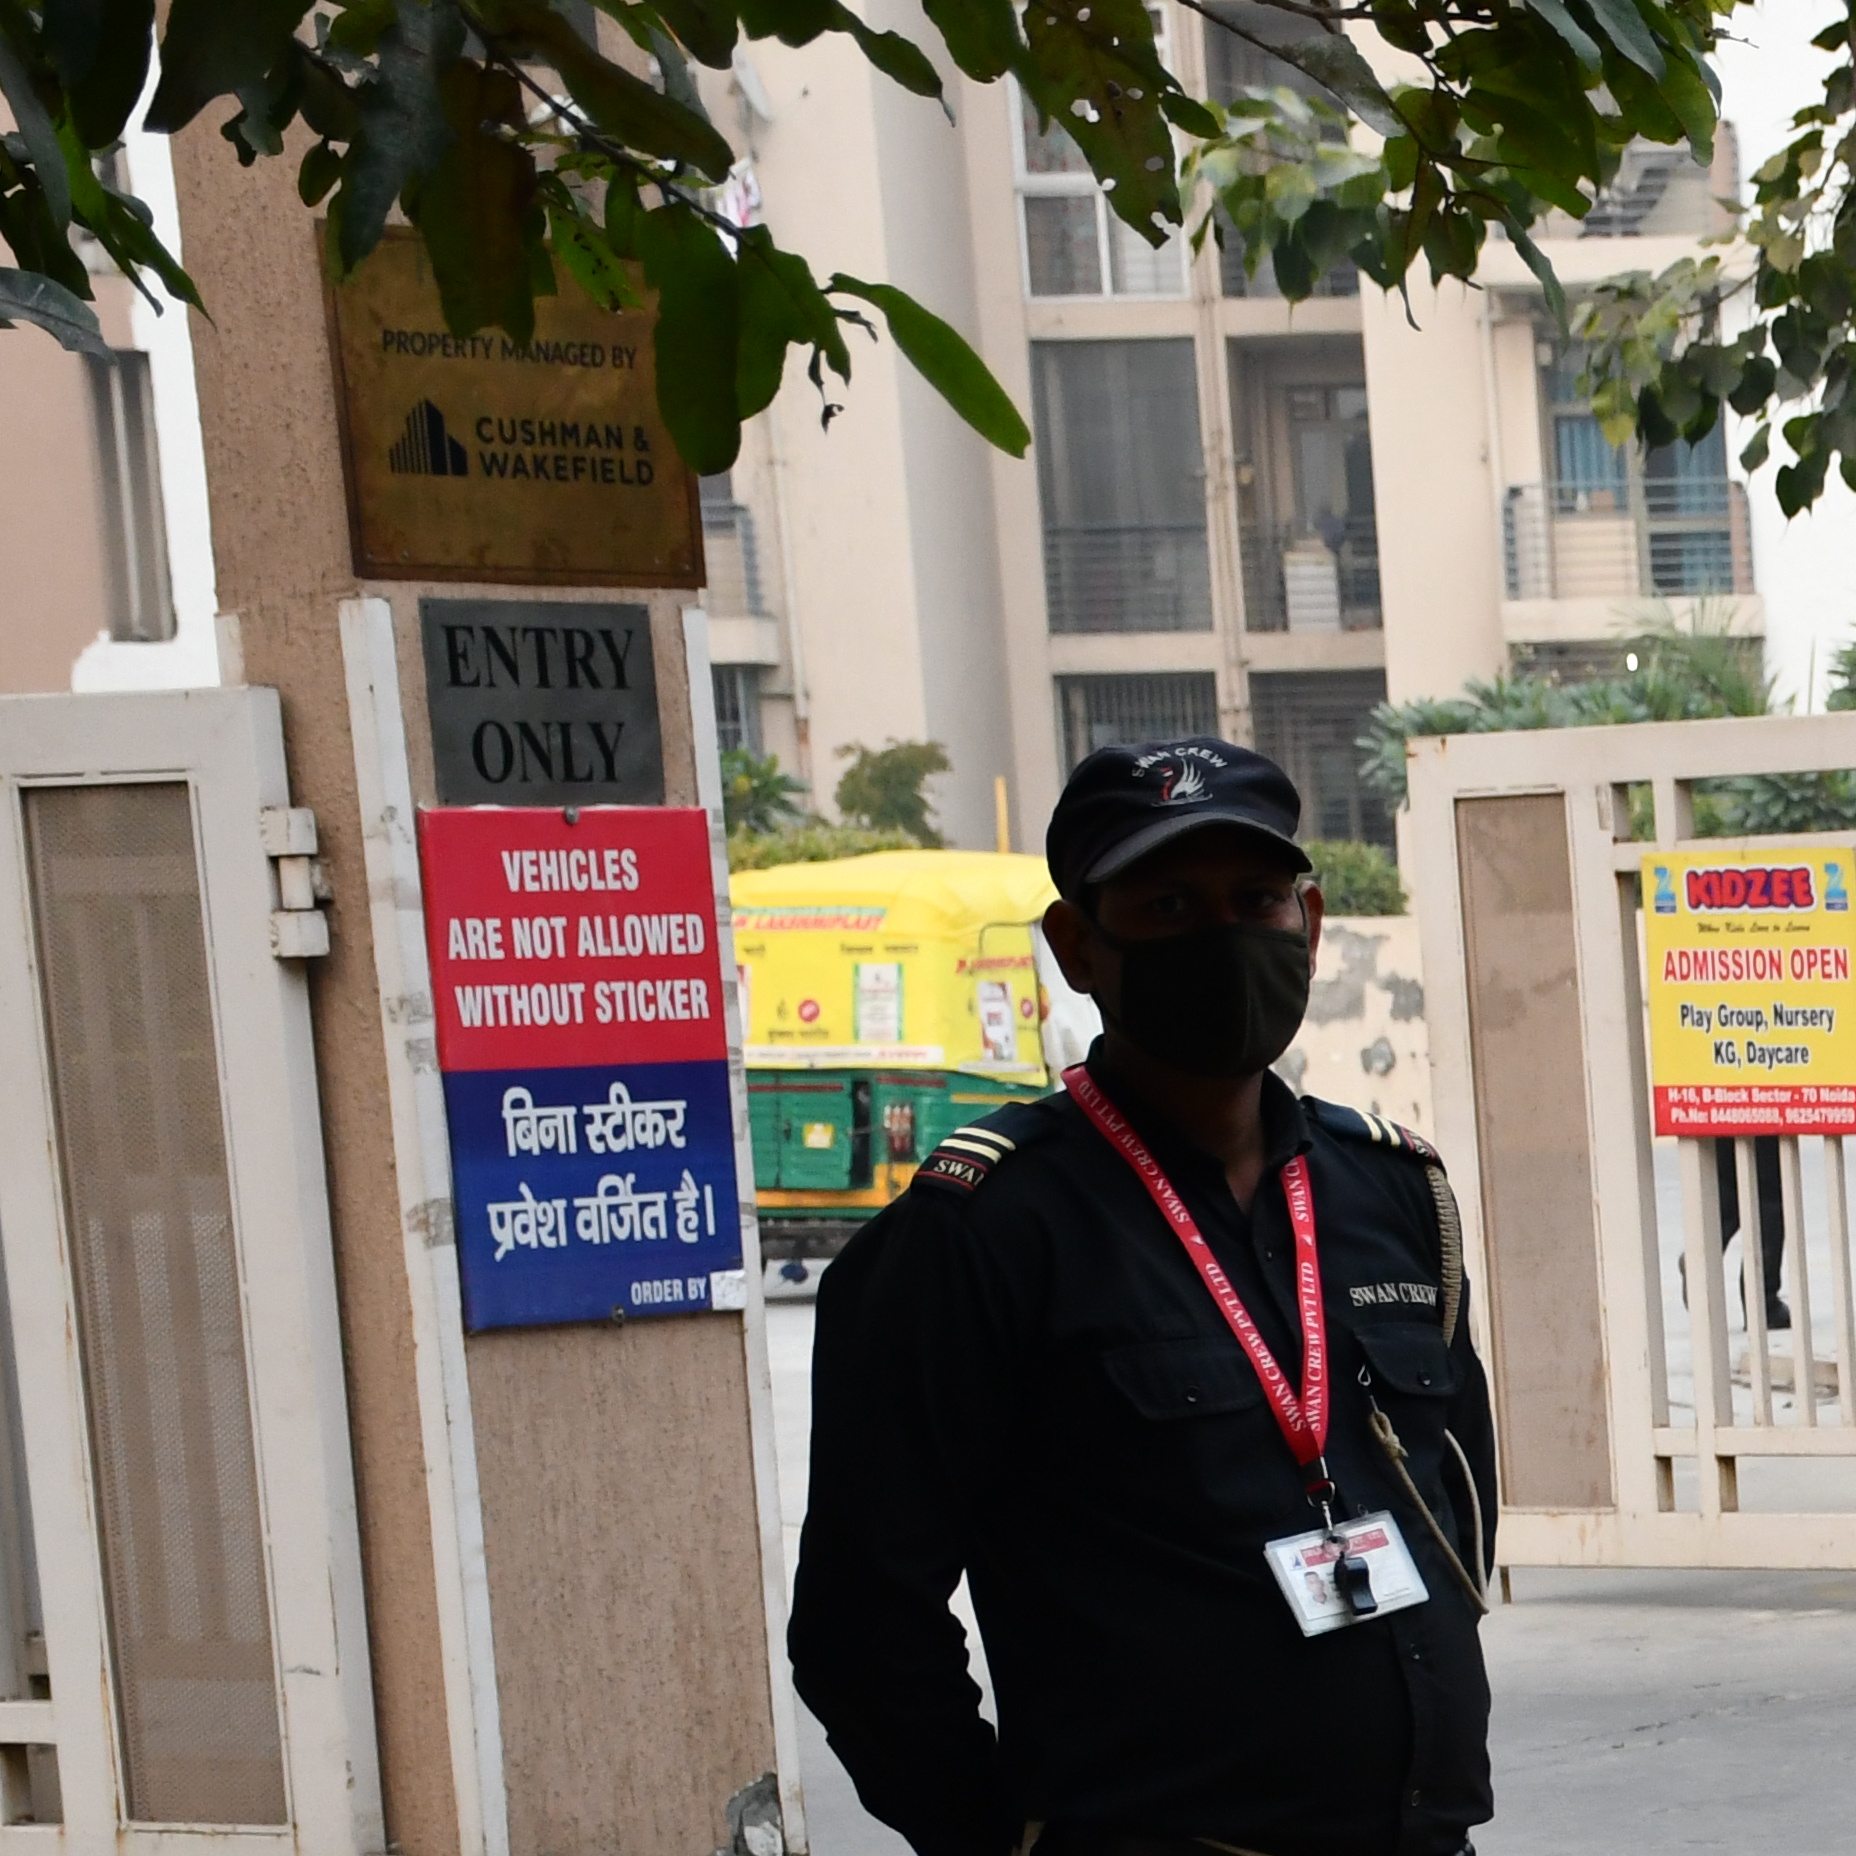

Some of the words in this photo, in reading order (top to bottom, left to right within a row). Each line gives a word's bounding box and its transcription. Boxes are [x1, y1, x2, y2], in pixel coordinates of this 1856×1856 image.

[382, 329, 494, 360] PROPERTY
[611, 345, 638, 370] BY
[475, 416, 623, 449] CUSHMAN
[633, 425, 651, 452] &
[478, 451, 655, 486] WAKEFIELD
[442, 624, 633, 690] ENTRY
[472, 720, 625, 784] ONLY
[1131, 750, 1172, 779] SWAN
[1174, 746, 1229, 769] CREW
[501, 848, 639, 892] VEHICLES
[1685, 866, 1816, 911] KIDZEE
[448, 917, 506, 960] ARE
[511, 916, 567, 959] NOT
[577, 913, 705, 958] ALLOWED
[1663, 949, 1783, 982] ADMISSION
[1790, 948, 1849, 980] OPEN
[454, 982, 585, 1028] WITHOUT
[594, 979, 710, 1024] STICKER
[1680, 1004, 1713, 1034] Play
[1718, 1004, 1769, 1032] Group,
[1773, 1004, 1835, 1033] Nursery
[1713, 1041, 1741, 1069] KG,
[1746, 1041, 1810, 1070] Daycare
[1078, 1080, 1100, 1108] LTD
[502, 1085, 578, 1158] बिना
[582, 1080, 687, 1154] स्टीकर
[1095, 1104, 1125, 1132] PVT
[1117, 1133, 1159, 1175] CREW
[487, 1181, 568, 1262] प्रवेश
[573, 1172, 668, 1245] वर्जित
[1153, 1177, 1191, 1223] SWAN
[631, 1278, 684, 1305] ORDER
[687, 1276, 708, 1301] BY
[1205, 1262, 1232, 1295] LTD
[1300, 1261, 1316, 1294] LTD
[1349, 1282, 1400, 1308] SWAN
[1398, 1282, 1438, 1307] CREW
[1223, 1297, 1253, 1329] PVT
[1302, 1296, 1319, 1328] PVT
[1244, 1331, 1281, 1381] CREW
[1306, 1330, 1322, 1381] CREW
[1271, 1383, 1307, 1432] SWAN
[1304, 1384, 1323, 1432] SWAN
